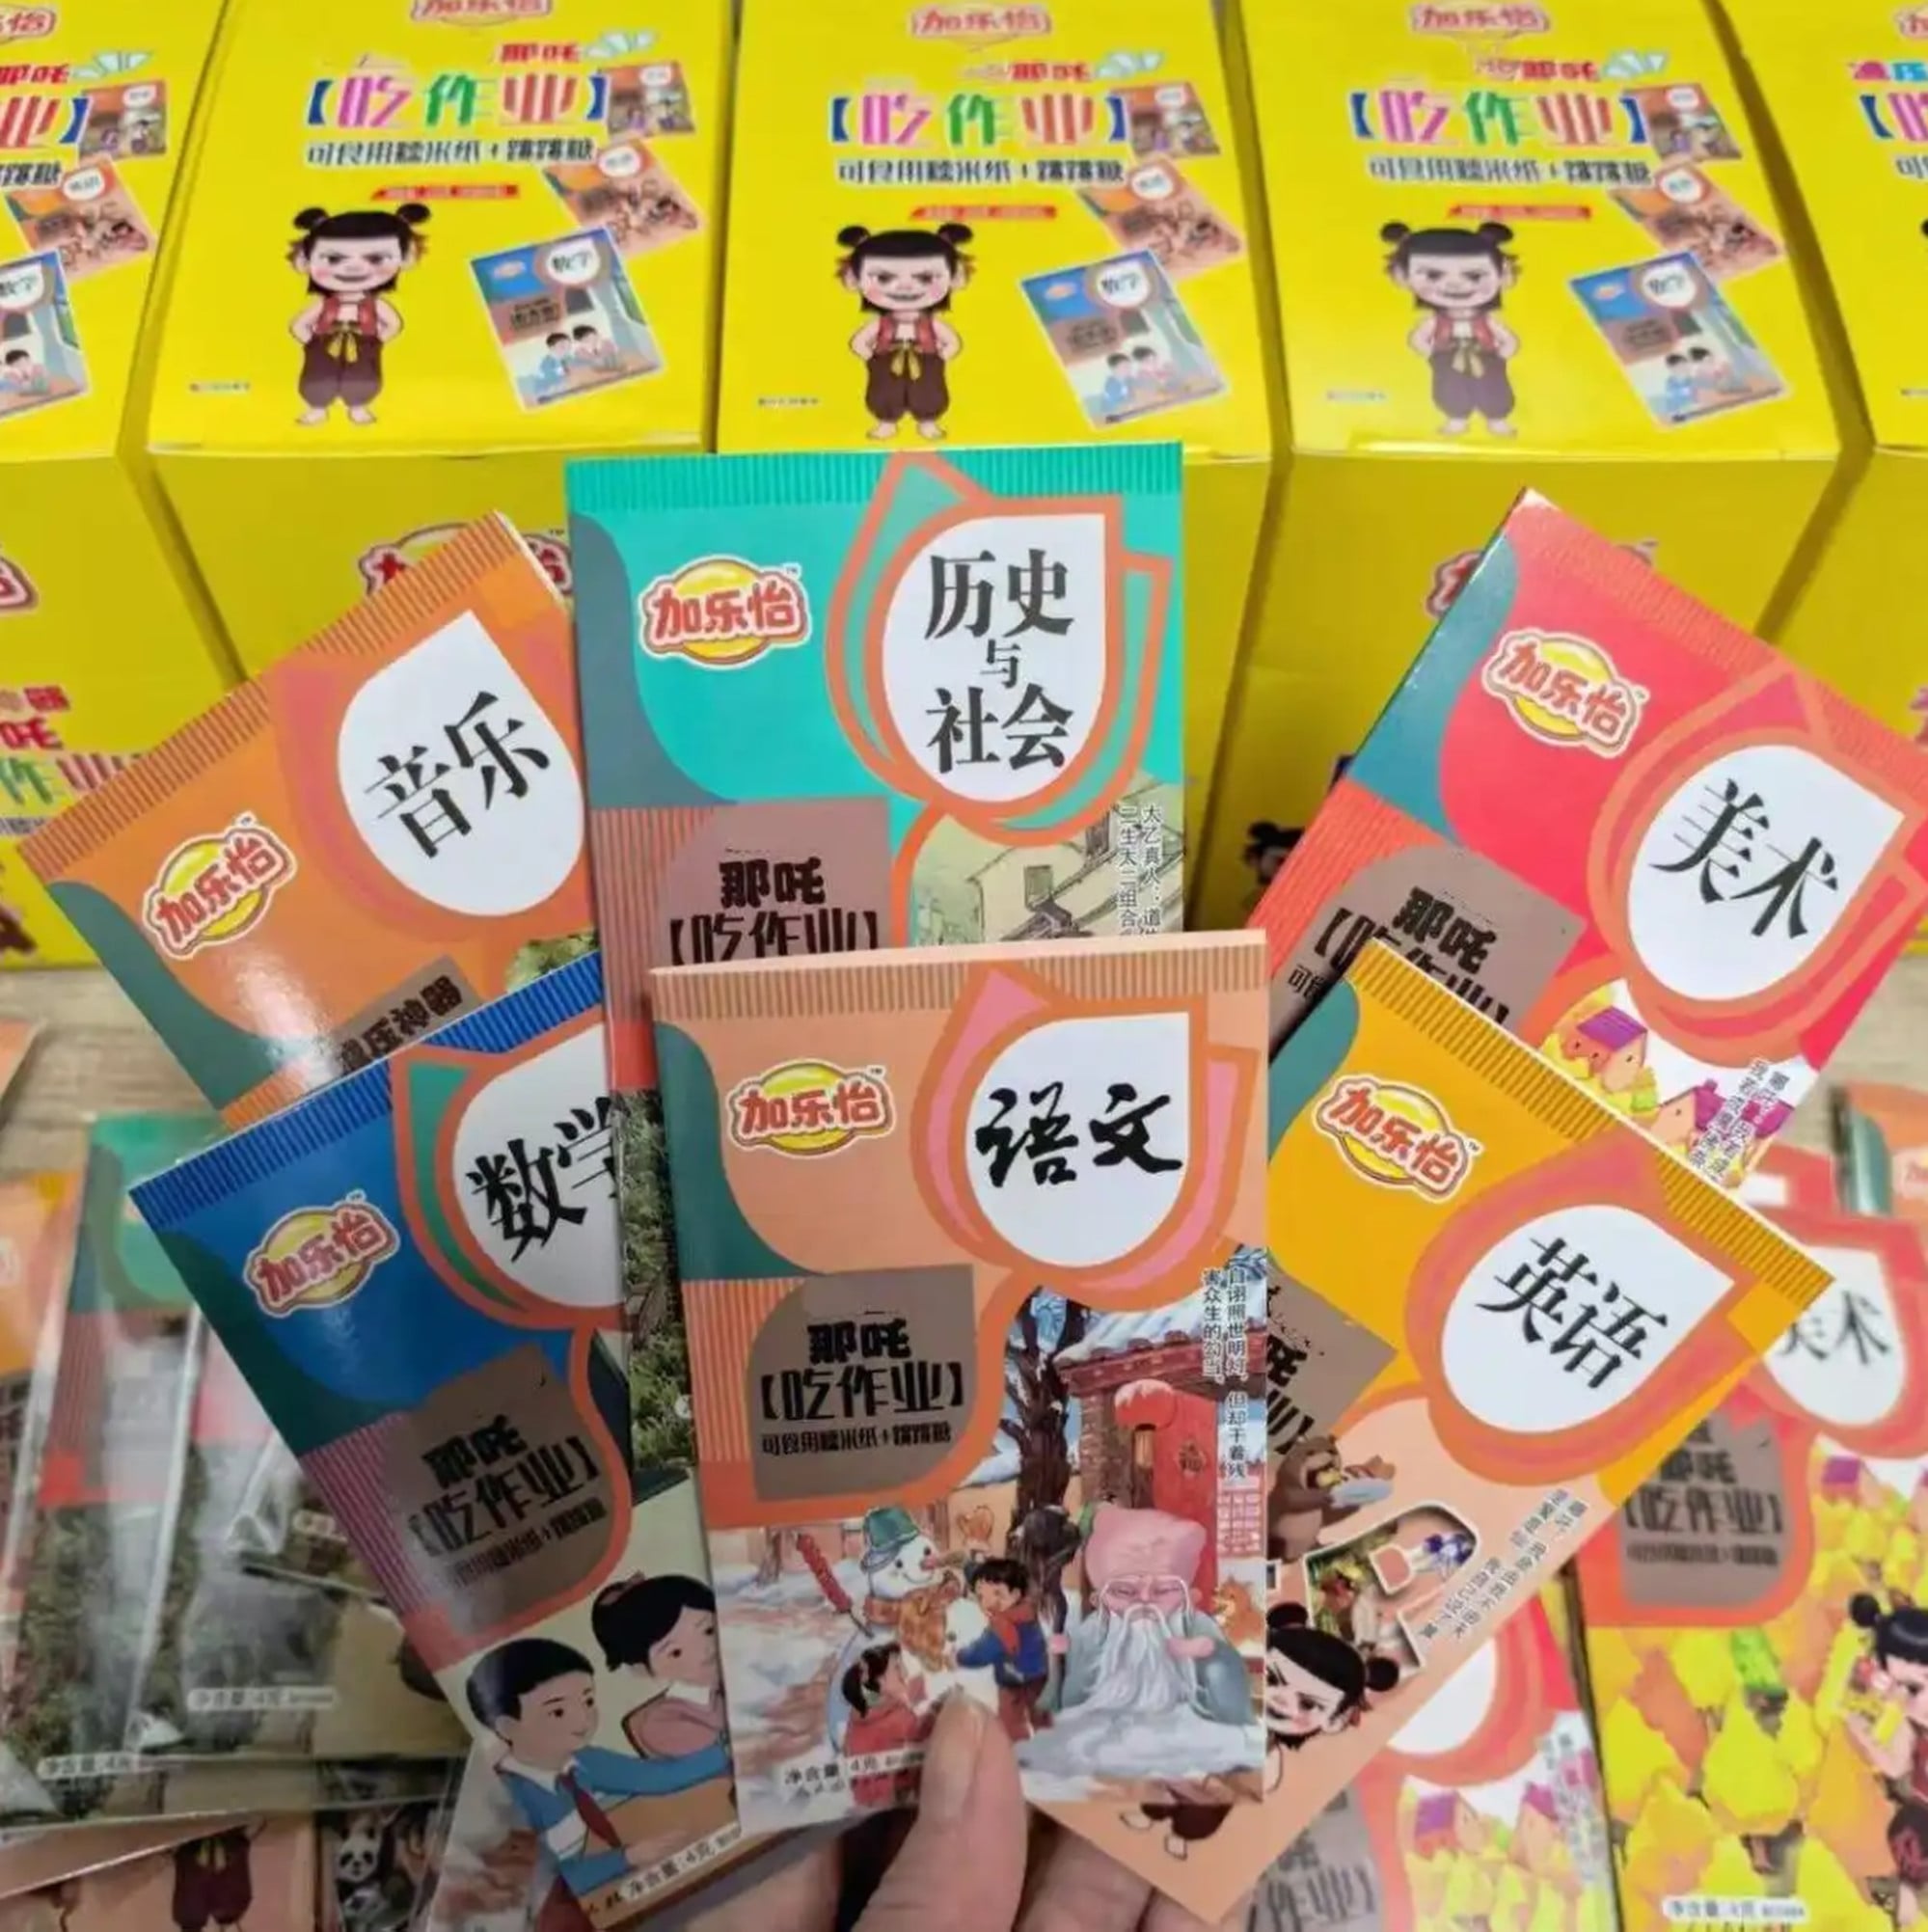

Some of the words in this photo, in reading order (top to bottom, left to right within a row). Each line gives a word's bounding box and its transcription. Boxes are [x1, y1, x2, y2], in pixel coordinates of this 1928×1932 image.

[651, 578, 802, 639] 加乐怡
[923, 548, 1074, 640] 历史
[980, 639, 1022, 689] 与
[1495, 639, 1629, 743] 加乐怡
[364, 691, 550, 859] 音乐
[925, 684, 1073, 774] 社会
[155, 833, 278, 944] 加乐怡
[1648, 776, 1839, 939] 美术
[741, 1080, 880, 1131] 加乐怡
[975, 1081, 1182, 1187] 语文
[1331, 1086, 1461, 1185] 加乐怡
[257, 1206, 386, 1303] 加乐怡
[1475, 1237, 1669, 1389] 英语
[760, 1360, 964, 1421] 【吃作业】
[761, 1421, 952, 1456] 可食用糯米纸+跳跳糖
